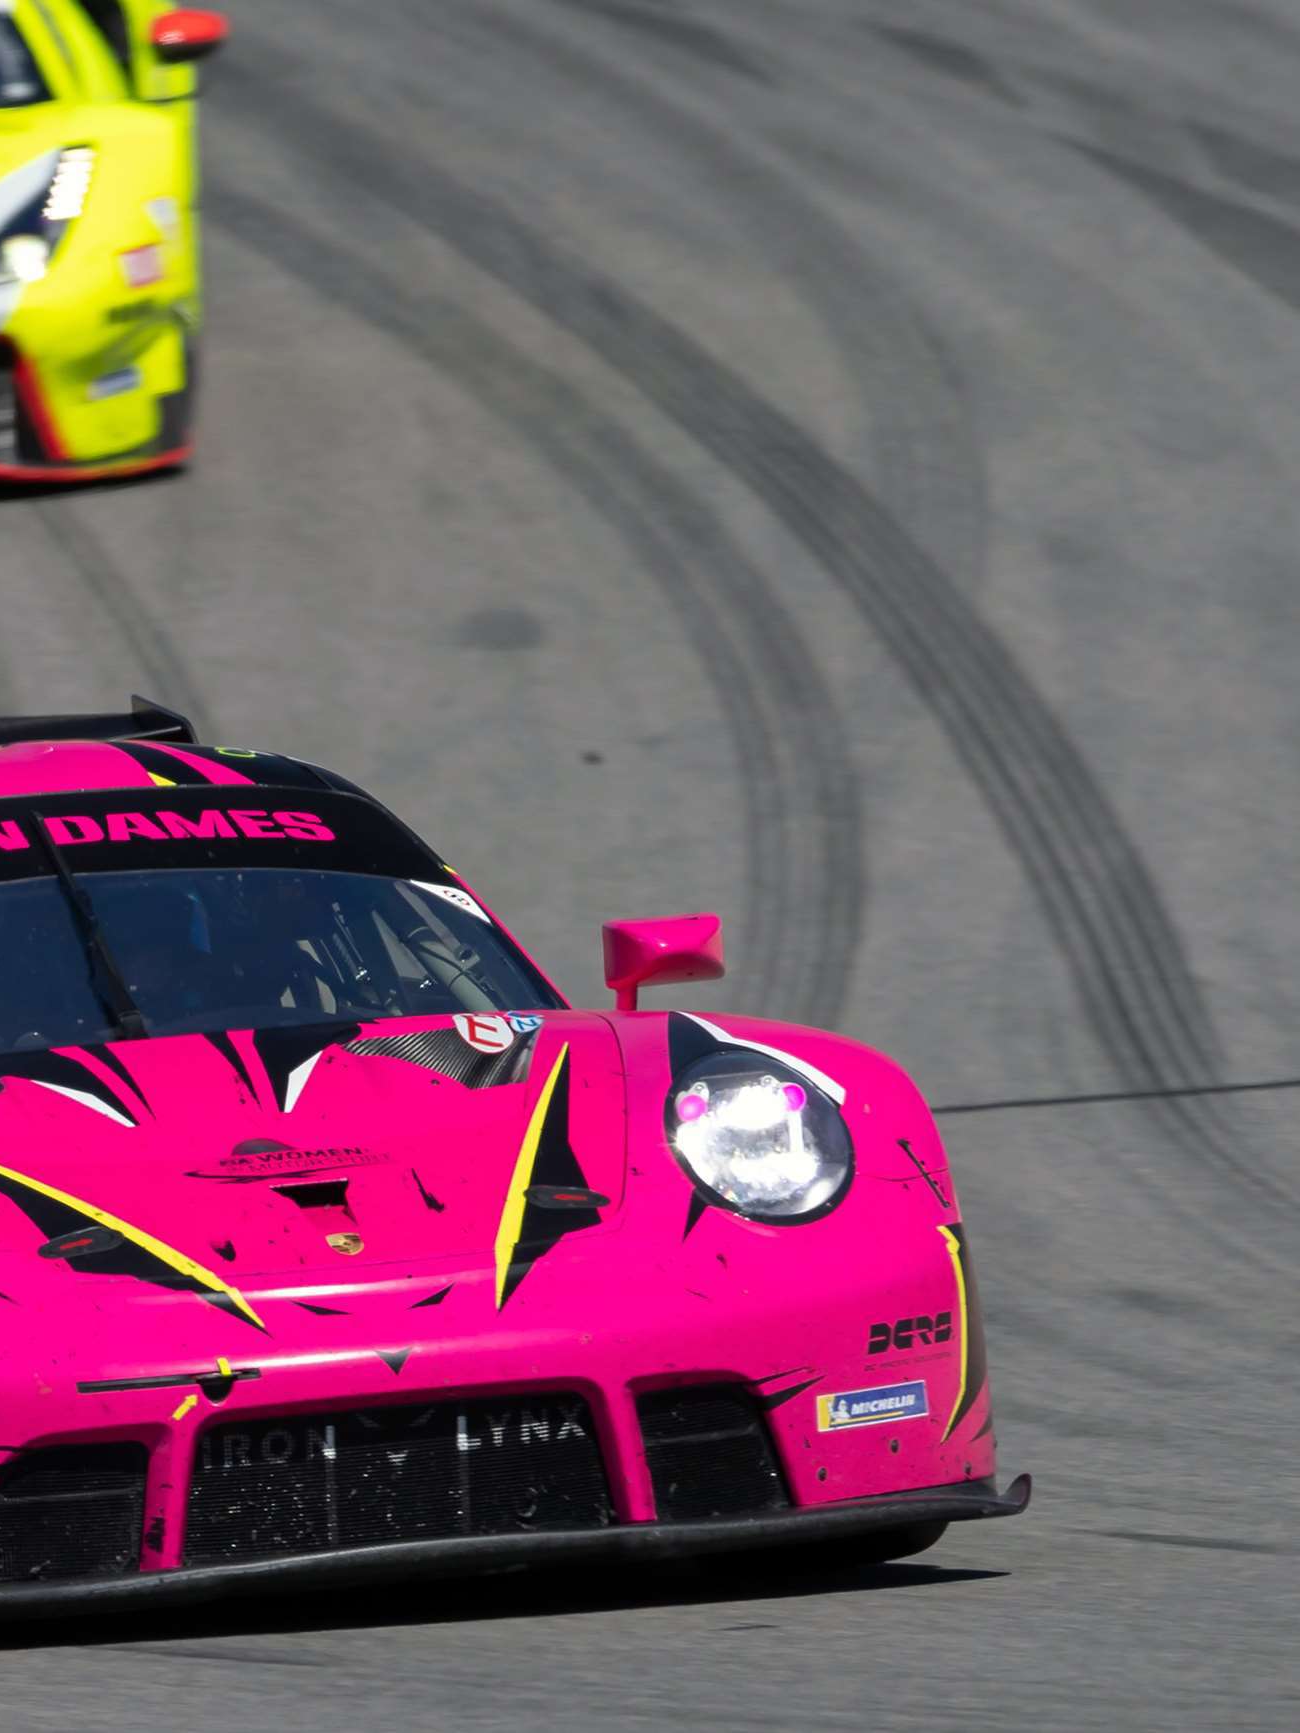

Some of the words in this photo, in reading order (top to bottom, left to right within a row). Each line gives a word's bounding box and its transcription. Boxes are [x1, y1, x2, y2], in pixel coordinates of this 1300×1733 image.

[41, 808, 336, 846] DAMES
[256, 1147, 364, 1163] WOMEN
[851, 1394, 916, 1416] MICHELIN
[203, 1425, 337, 1469] IRON
[457, 1403, 587, 1452] LYNX
